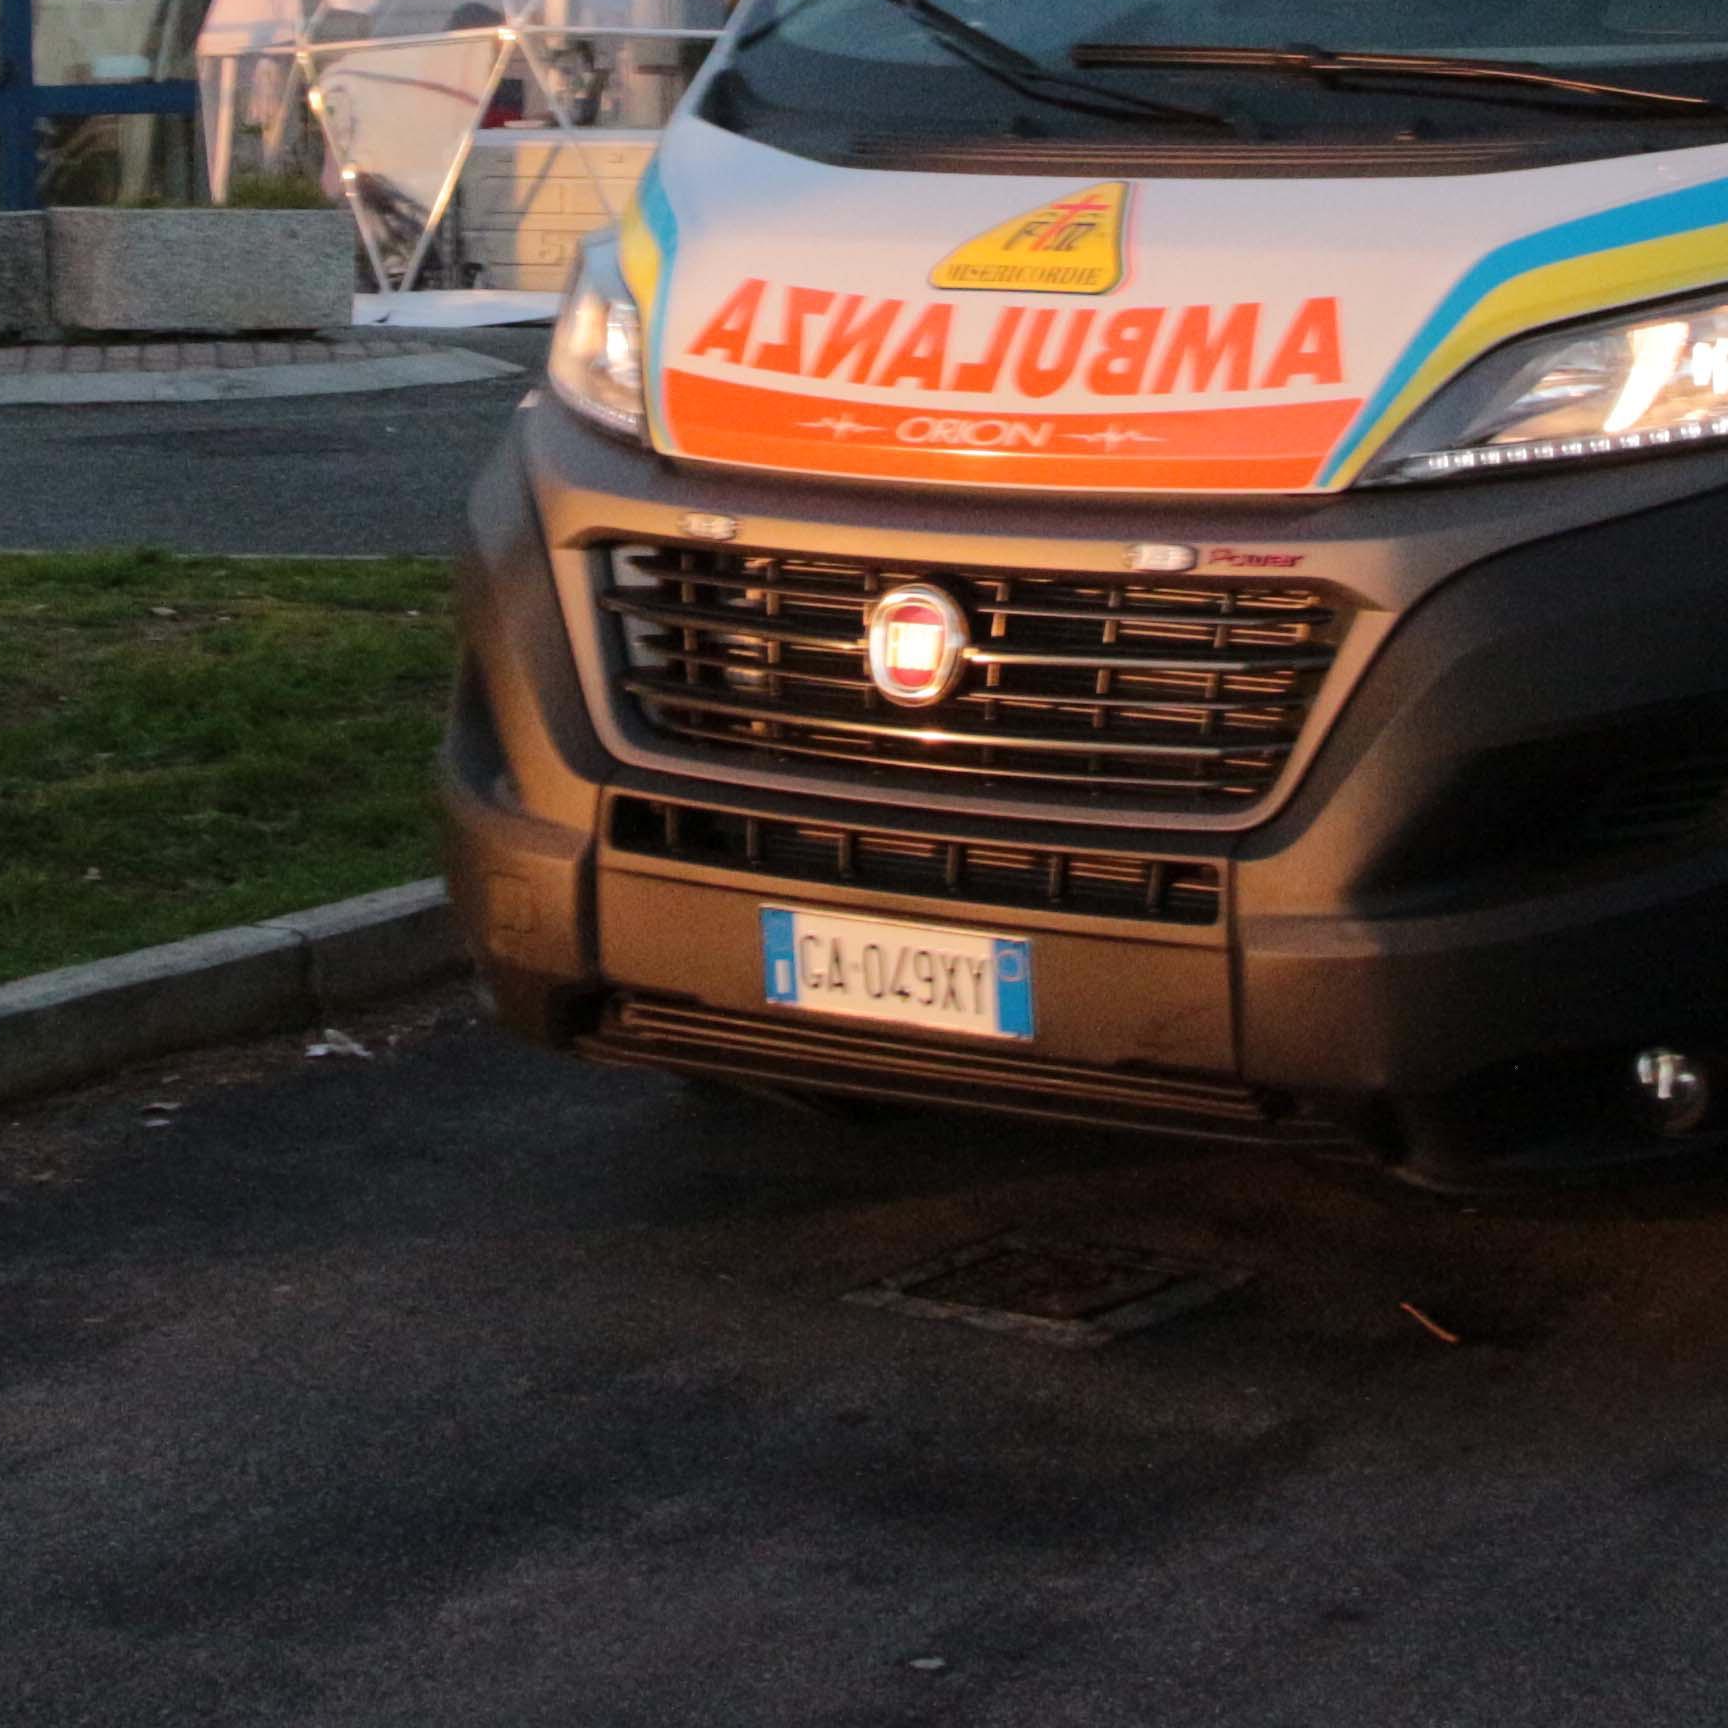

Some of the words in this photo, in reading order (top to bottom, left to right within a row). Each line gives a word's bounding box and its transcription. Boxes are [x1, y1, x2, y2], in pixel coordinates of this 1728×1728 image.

[948, 262, 1103, 286] MISERICORDIE
[894, 415, 1056, 449] ORION
[1207, 547, 1305, 568] Power
